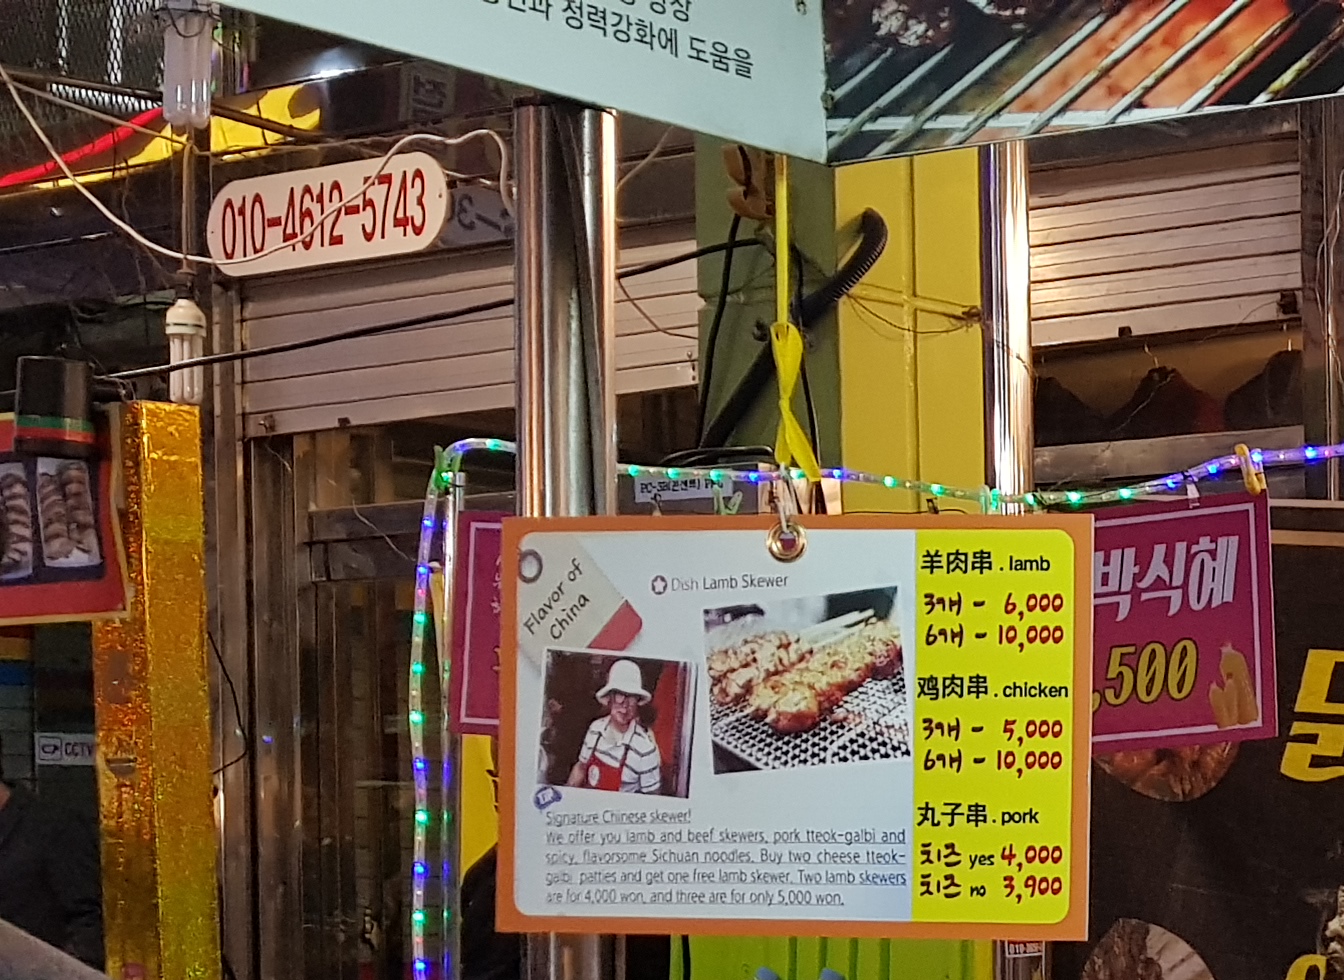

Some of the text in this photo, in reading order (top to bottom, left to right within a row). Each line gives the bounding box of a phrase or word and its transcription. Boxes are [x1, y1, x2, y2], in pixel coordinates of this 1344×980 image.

[562, 0, 679, 59] 정력강화에
[687, 35, 754, 79] 도움을
[221, 167, 427, 260] 010-4612-5743
[921, 549, 1051, 575] 羊肉串 lamb
[523, 556, 583, 636] Flavor of
[671, 573, 790, 592] Dish Lamb Skewer
[550, 593, 591, 640] China
[923, 591, 962, 616] 3개
[1004, 592, 1064, 621] 6,000
[925, 622, 964, 648] 6개
[998, 624, 1065, 653] 10,000
[917, 673, 1069, 701] 鸡肉串 chicken
[922, 717, 961, 742] 3개
[1002, 719, 1063, 748] 5,000
[923, 748, 963, 773] 6개
[996, 750, 1063, 779] 10,000
[546, 808, 692, 827] Signature Chinese skewer!
[916, 801, 1040, 828] 丸子串 pork
[546, 831, 565, 844] We
[568, 829, 596, 844] offer
[600, 832, 621, 845] you
[626, 829, 656, 843] lamb
[660, 829, 682, 843] and
[687, 828, 715, 843] beef
[773, 828, 801, 845] pork
[806, 828, 876, 846] tteok-galbi
[880, 829, 906, 844] and
[583, 850, 647, 865] flavorsome
[651, 848, 699, 864] Sichuan
[760, 848, 784, 865] Buy
[788, 850, 811, 863] two
[816, 849, 861, 864] cheese
[866, 849, 907, 864] tteok-
[919, 842, 1063, 872] 치즈 yes 4,000
[579, 870, 617, 886] patties
[620, 869, 643, 884] and
[645, 870, 664, 886] get
[667, 871, 690, 885] one
[692, 868, 715, 884] free
[718, 869, 748, 884] lamb
[797, 869, 822, 884] Two
[825, 870, 856, 885] lamb
[859, 870, 907, 886] skewers
[919, 873, 1063, 904] 치즈 no 3,900
[546, 891, 564, 904] are
[566, 889, 582, 902] for
[584, 889, 617, 905] 4,000
[651, 889, 674, 903] and
[676, 889, 706, 904] three
[708, 891, 727, 904] are
[730, 889, 746, 903] for
[749, 888, 774, 906] only
[778, 889, 812, 906] 5,000
